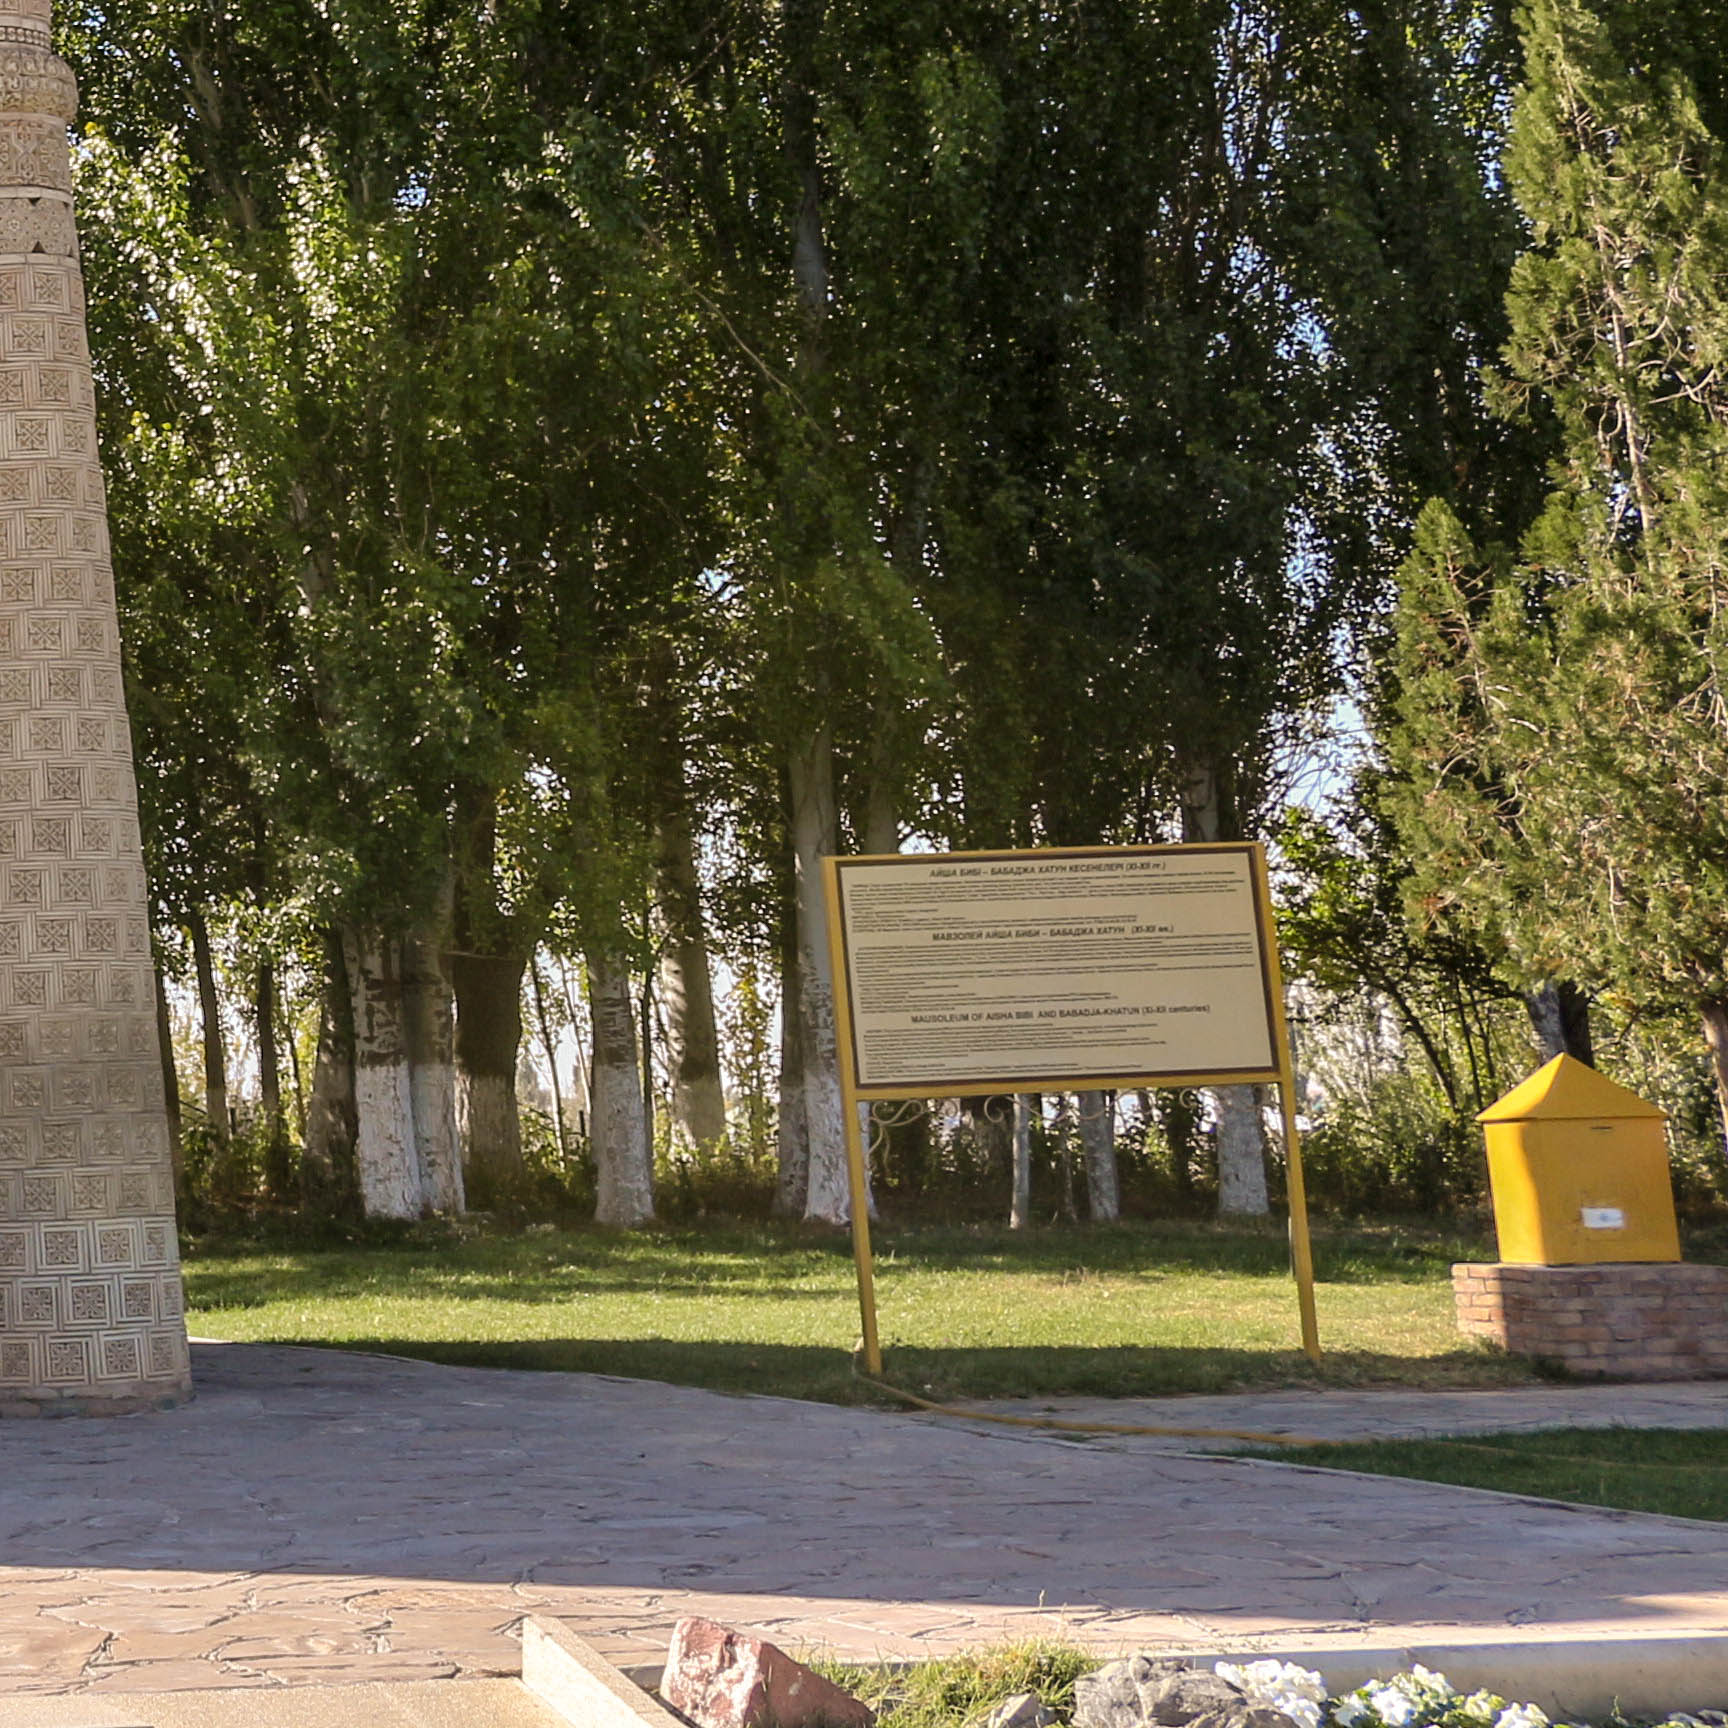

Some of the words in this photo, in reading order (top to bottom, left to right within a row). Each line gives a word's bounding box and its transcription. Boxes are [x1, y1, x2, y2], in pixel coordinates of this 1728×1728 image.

[932, 930, 983, 941] МАВЗОЛЕЙ
[911, 1013, 969, 1023] MAUSOLEUM
[971, 1012, 982, 1021] OF
[1038, 1010, 1057, 1018] AND
